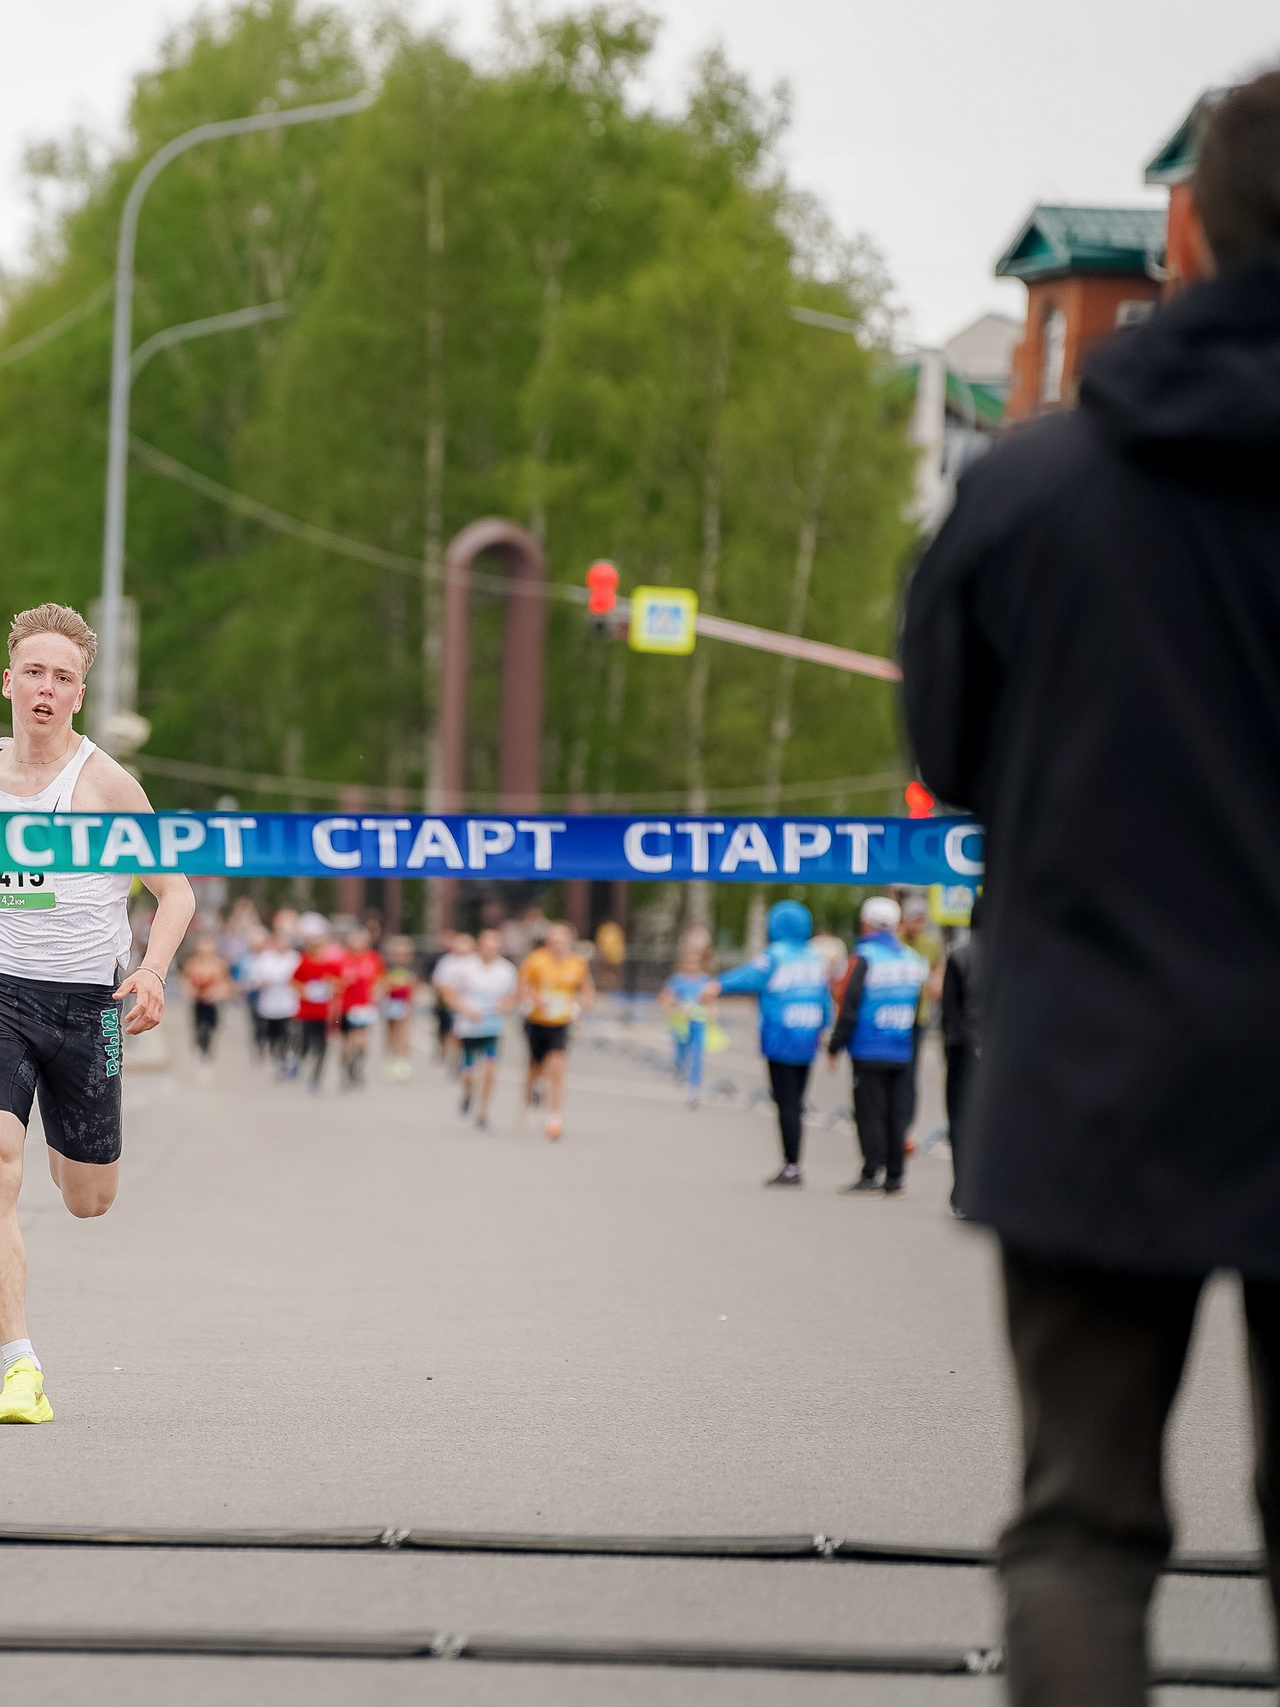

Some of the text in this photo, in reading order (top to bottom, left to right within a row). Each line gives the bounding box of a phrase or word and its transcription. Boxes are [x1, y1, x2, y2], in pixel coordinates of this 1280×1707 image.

[5, 815, 257, 868] СТАРТ
[312, 818, 566, 870] СТАРТ
[623, 822, 884, 874] СТАРТ
